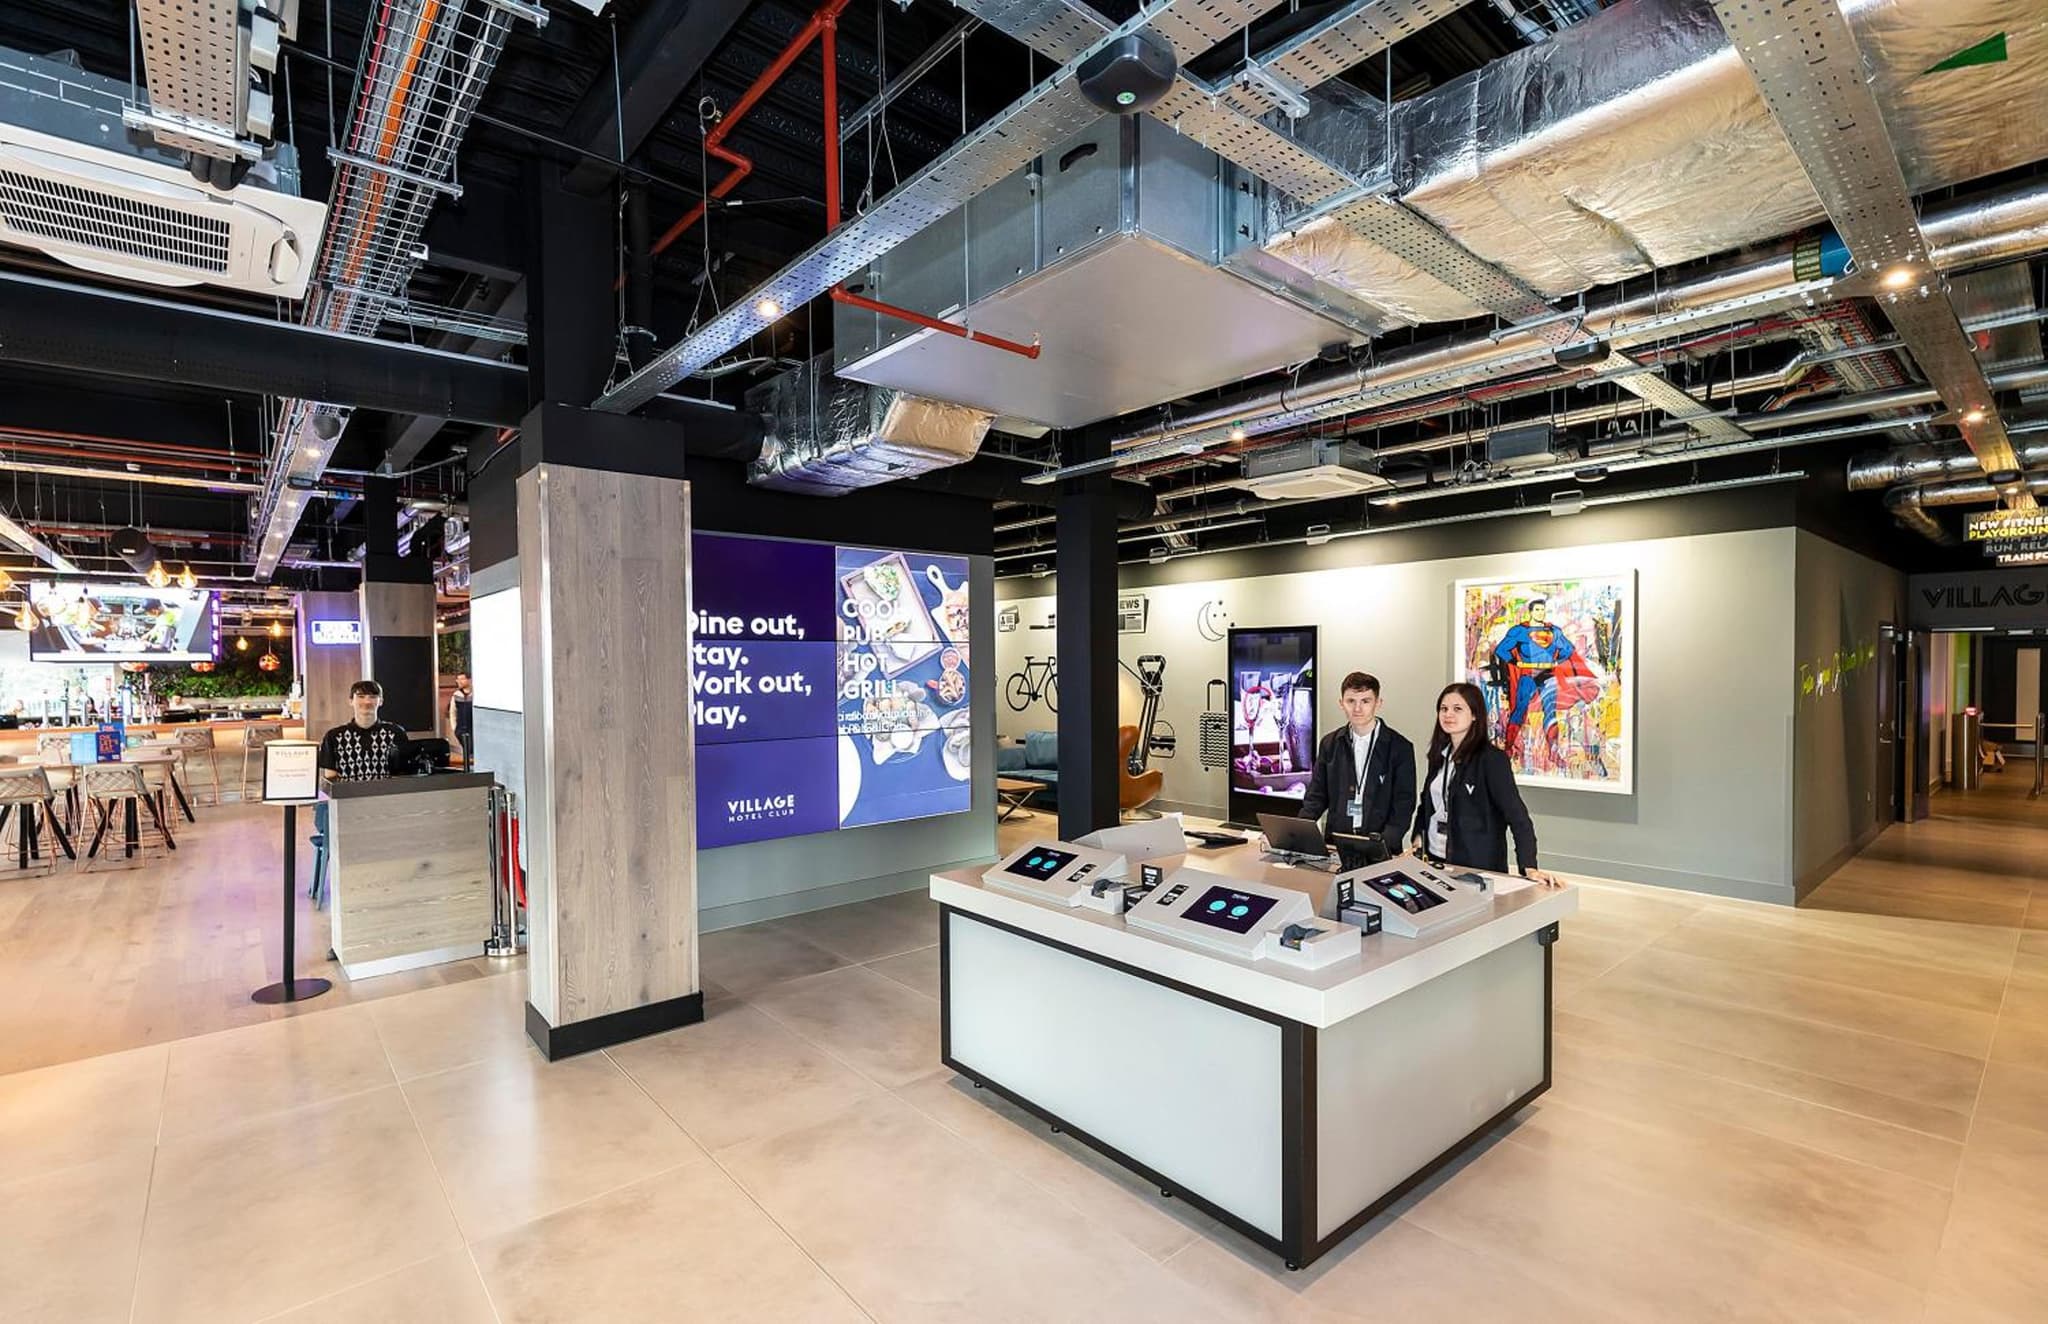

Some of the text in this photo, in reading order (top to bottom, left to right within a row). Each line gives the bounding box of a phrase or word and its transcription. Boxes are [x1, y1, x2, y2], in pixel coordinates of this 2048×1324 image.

[1968, 520, 2000, 531] NEW
[1997, 552, 2034, 563] TRAIN
[1119, 599, 1140, 610] EWS
[1921, 583, 2048, 608] VILLAG
[750, 614, 805, 640] out,
[692, 643, 750, 671] tay.
[843, 652, 888, 673] HOT
[758, 672, 812, 697] out,
[692, 700, 748, 730] lay.
[728, 794, 794, 814] VILLAGE
[728, 809, 794, 823] HOTEL CLUB
